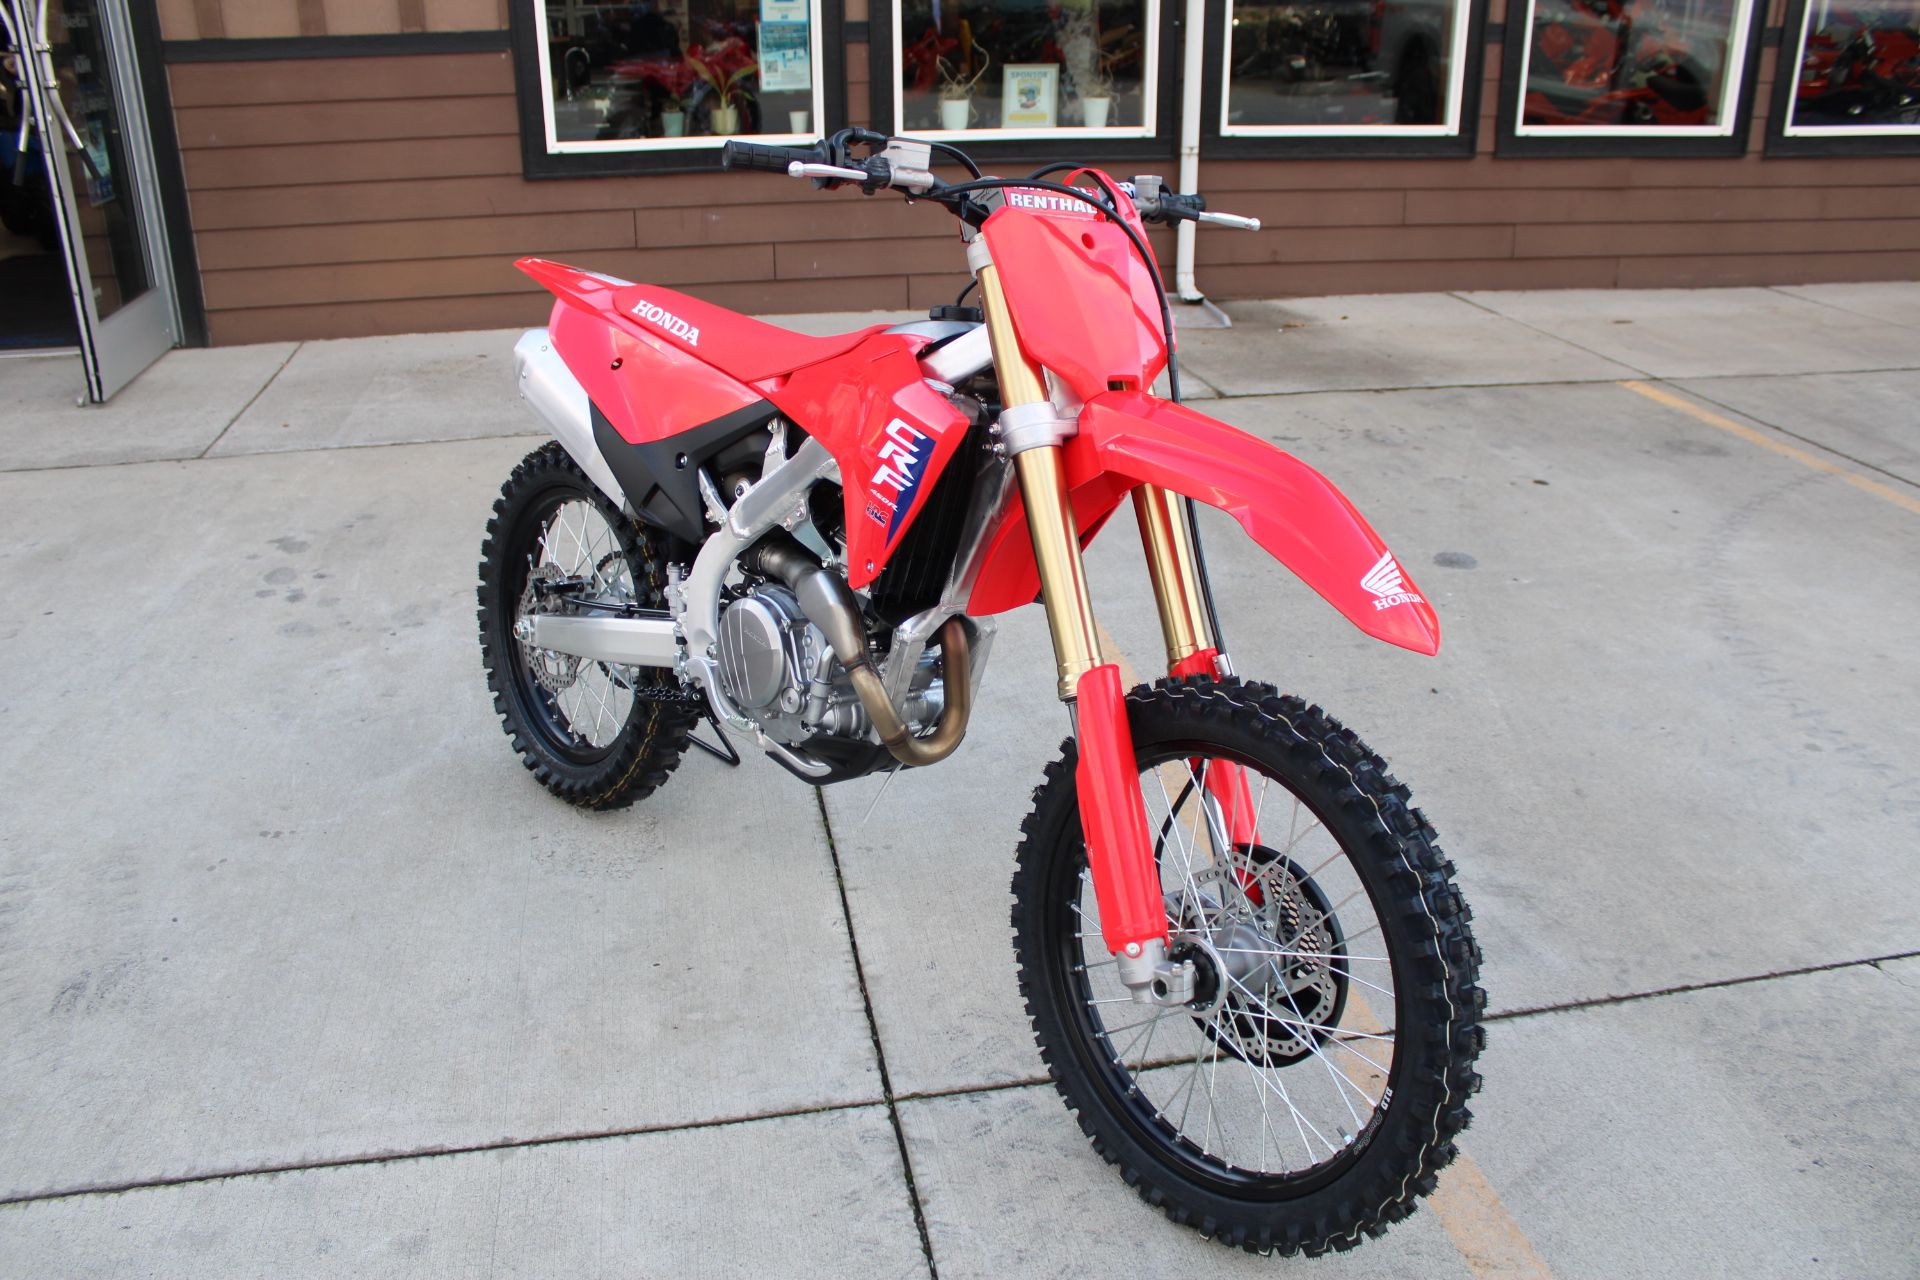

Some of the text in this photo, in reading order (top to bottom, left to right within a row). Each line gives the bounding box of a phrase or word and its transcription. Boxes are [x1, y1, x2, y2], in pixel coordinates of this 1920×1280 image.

[1010, 192, 1098, 214] RENTHAL
[631, 299, 700, 347] HONDA
[871, 417, 927, 492] CRF
[870, 488, 899, 512] 450R
[1372, 592, 1425, 611] HONDA
